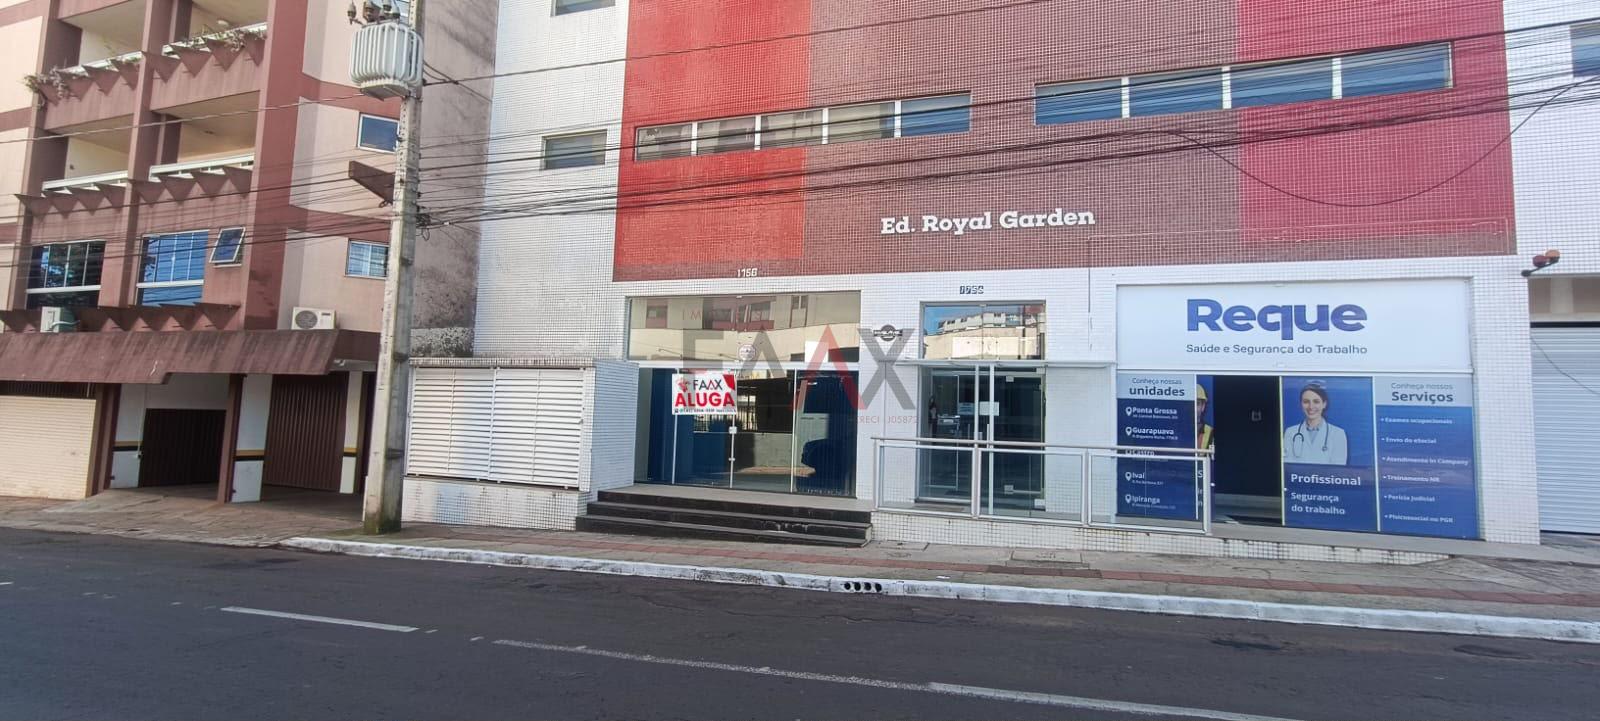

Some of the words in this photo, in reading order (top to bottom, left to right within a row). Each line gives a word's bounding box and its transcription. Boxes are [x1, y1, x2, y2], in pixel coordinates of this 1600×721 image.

[880, 216, 916, 234] Ed.
[922, 211, 992, 235] Royal
[999, 208, 1096, 229] Garden
[1187, 298, 1368, 341] Reque
[1186, 344, 1221, 353] Saúde
[1233, 344, 1294, 355] Segurança
[1297, 345, 1312, 354] do
[1315, 345, 1368, 354] Trabalho
[1129, 386, 1185, 397] unidades
[675, 392, 735, 407] ALUGA
[1391, 391, 1454, 405] Serviços
[1132, 427, 1175, 436] Guarapuava
[1291, 474, 1361, 486] Profissional
[1132, 496, 1161, 505] Ipiranga
[1291, 492, 1339, 503] Segurança
[1291, 504, 1304, 512] do
[1305, 506, 1346, 515] trabalho
